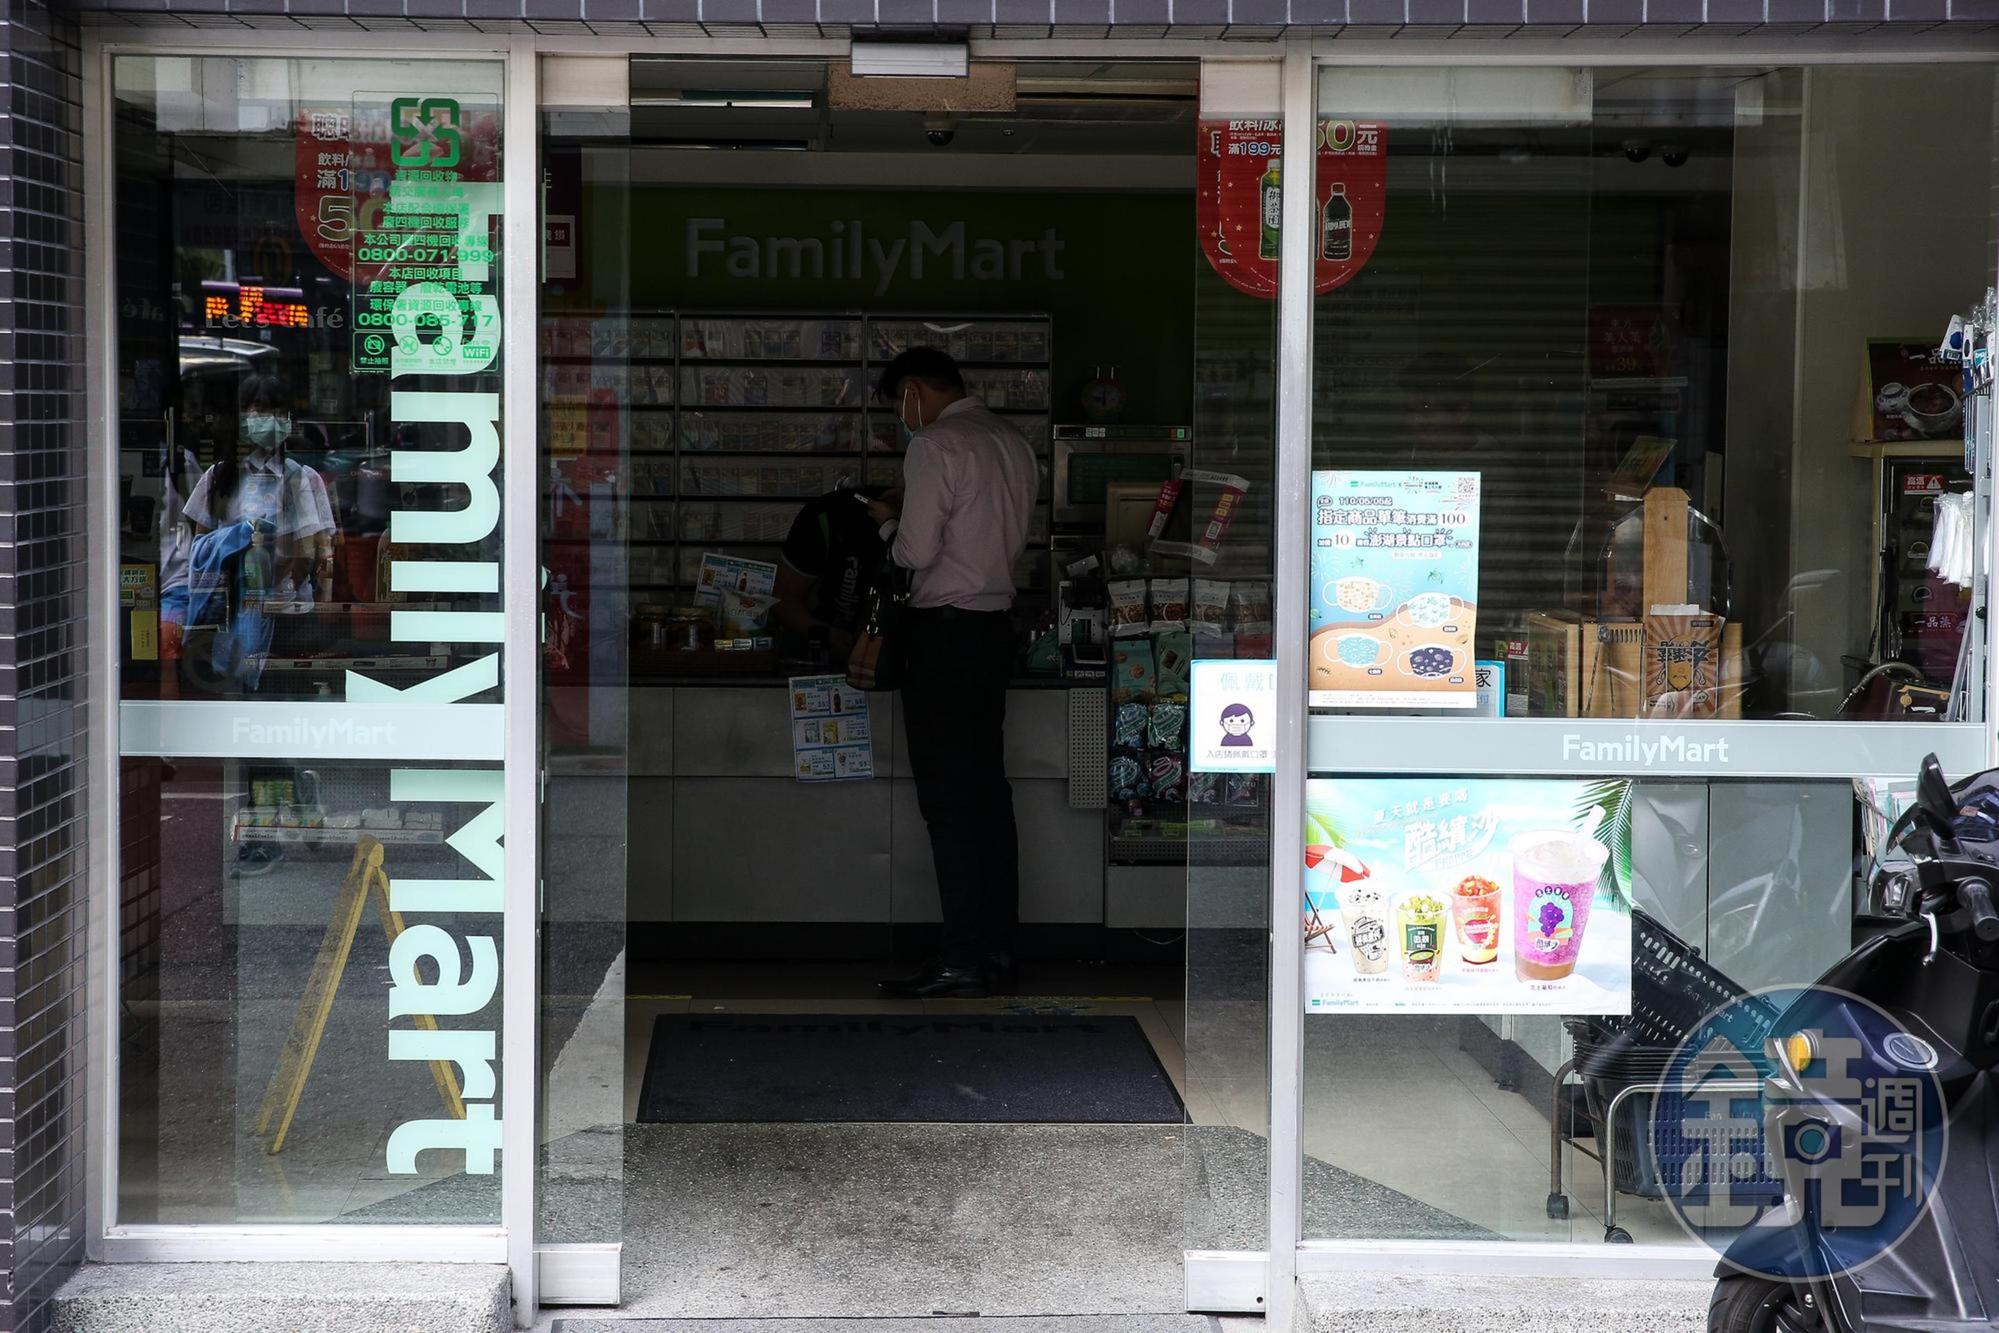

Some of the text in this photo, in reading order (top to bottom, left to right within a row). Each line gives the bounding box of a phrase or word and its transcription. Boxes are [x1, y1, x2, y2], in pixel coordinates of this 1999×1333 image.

[1229, 119, 1282, 132] 飲料/冰
[1229, 141, 1282, 156] 滿199元
[358, 248, 495, 262] 0800-071-999
[686, 217, 1065, 297] FamilyMart
[388, 267, 464, 280] 本店回收項目
[358, 313, 494, 327] 0800-085-717
[463, 347, 491, 359] WiFi
[1441, 513, 1466, 525] 100
[1335, 533, 1350, 546] 10
[232, 716, 398, 750] FamilyMart
[1562, 734, 1729, 767] FamilyMart
[1321, 999, 1359, 1009] FamilyMart
